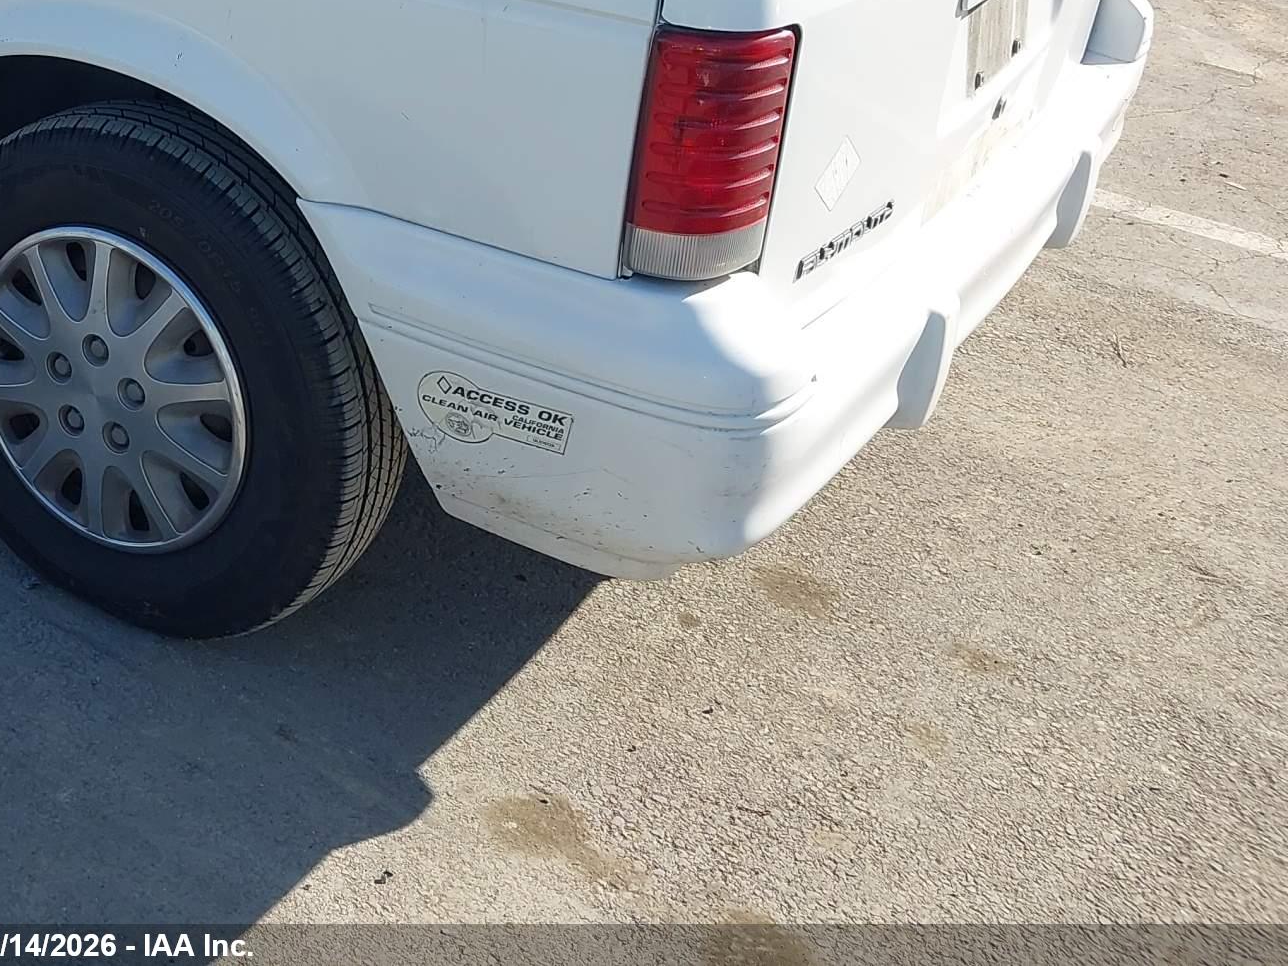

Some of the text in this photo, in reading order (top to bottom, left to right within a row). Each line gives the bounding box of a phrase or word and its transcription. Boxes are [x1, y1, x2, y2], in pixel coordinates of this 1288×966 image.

[422, 394, 564, 441] CLEAN AIR VEHICLE
[452, 386, 568, 427] ACCESS OK
[512, 415, 564, 434] CALIFORNIA
